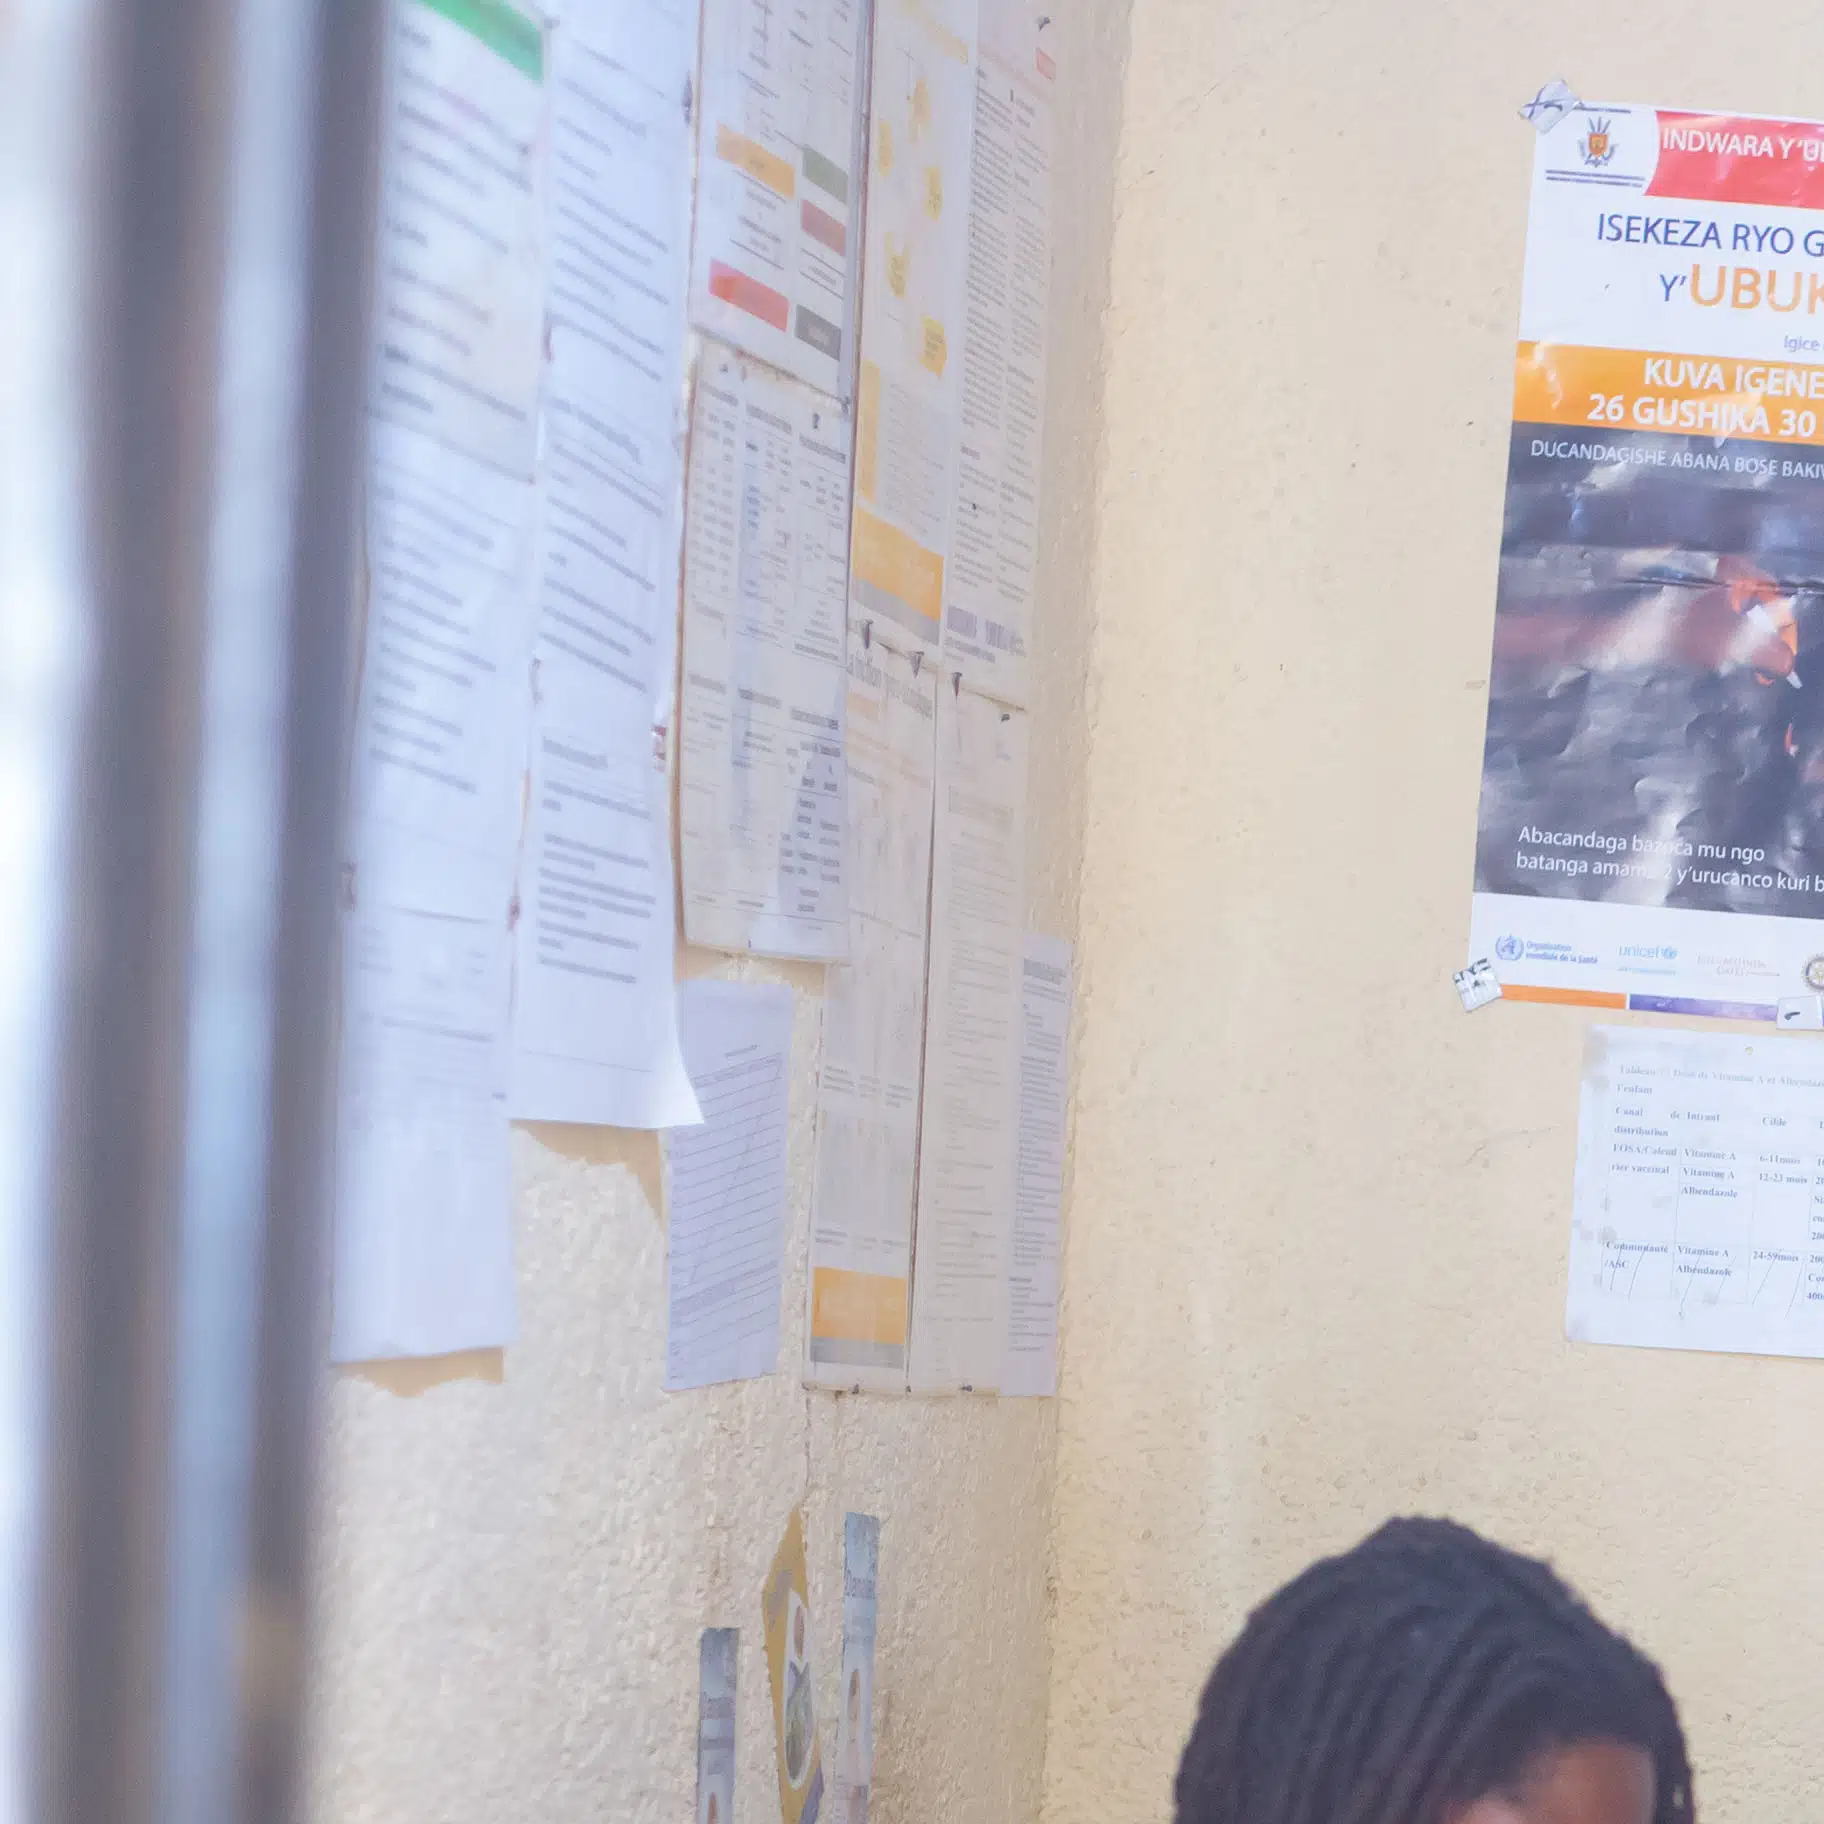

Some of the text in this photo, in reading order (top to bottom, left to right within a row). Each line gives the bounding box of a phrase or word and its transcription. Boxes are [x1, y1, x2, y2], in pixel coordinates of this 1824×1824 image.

[1662, 126, 1775, 158] INDWARA
[1597, 213, 1722, 250] ISEKEZA
[1732, 223, 1795, 255] RYO
[1643, 358, 1726, 392] KUVA
[1586, 393, 1625, 422] 26
[1631, 396, 1770, 435] GUSHIKA
[1779, 409, 1817, 438] 30
[1530, 439, 1667, 468] DUCANDAGISHE
[1670, 454, 1730, 472] ABANA
[1733, 457, 1778, 475] BOSE
[1518, 825, 1766, 865] Abacandaga mu ngo
[1516, 852, 1588, 876] batanga
[1777, 871, 1810, 891] kuri
[1683, 1148, 1727, 1160] Vitamine
[1729, 1152, 1737, 1161] A
[1682, 1167, 1725, 1178] Vitamine
[1727, 1171, 1736, 1180] A
[1680, 1186, 1738, 1198] Albendazole
[1677, 1245, 1719, 1257] Vitamine
[1722, 1249, 1730, 1258] A
[1676, 1265, 1733, 1277] Albendazole
